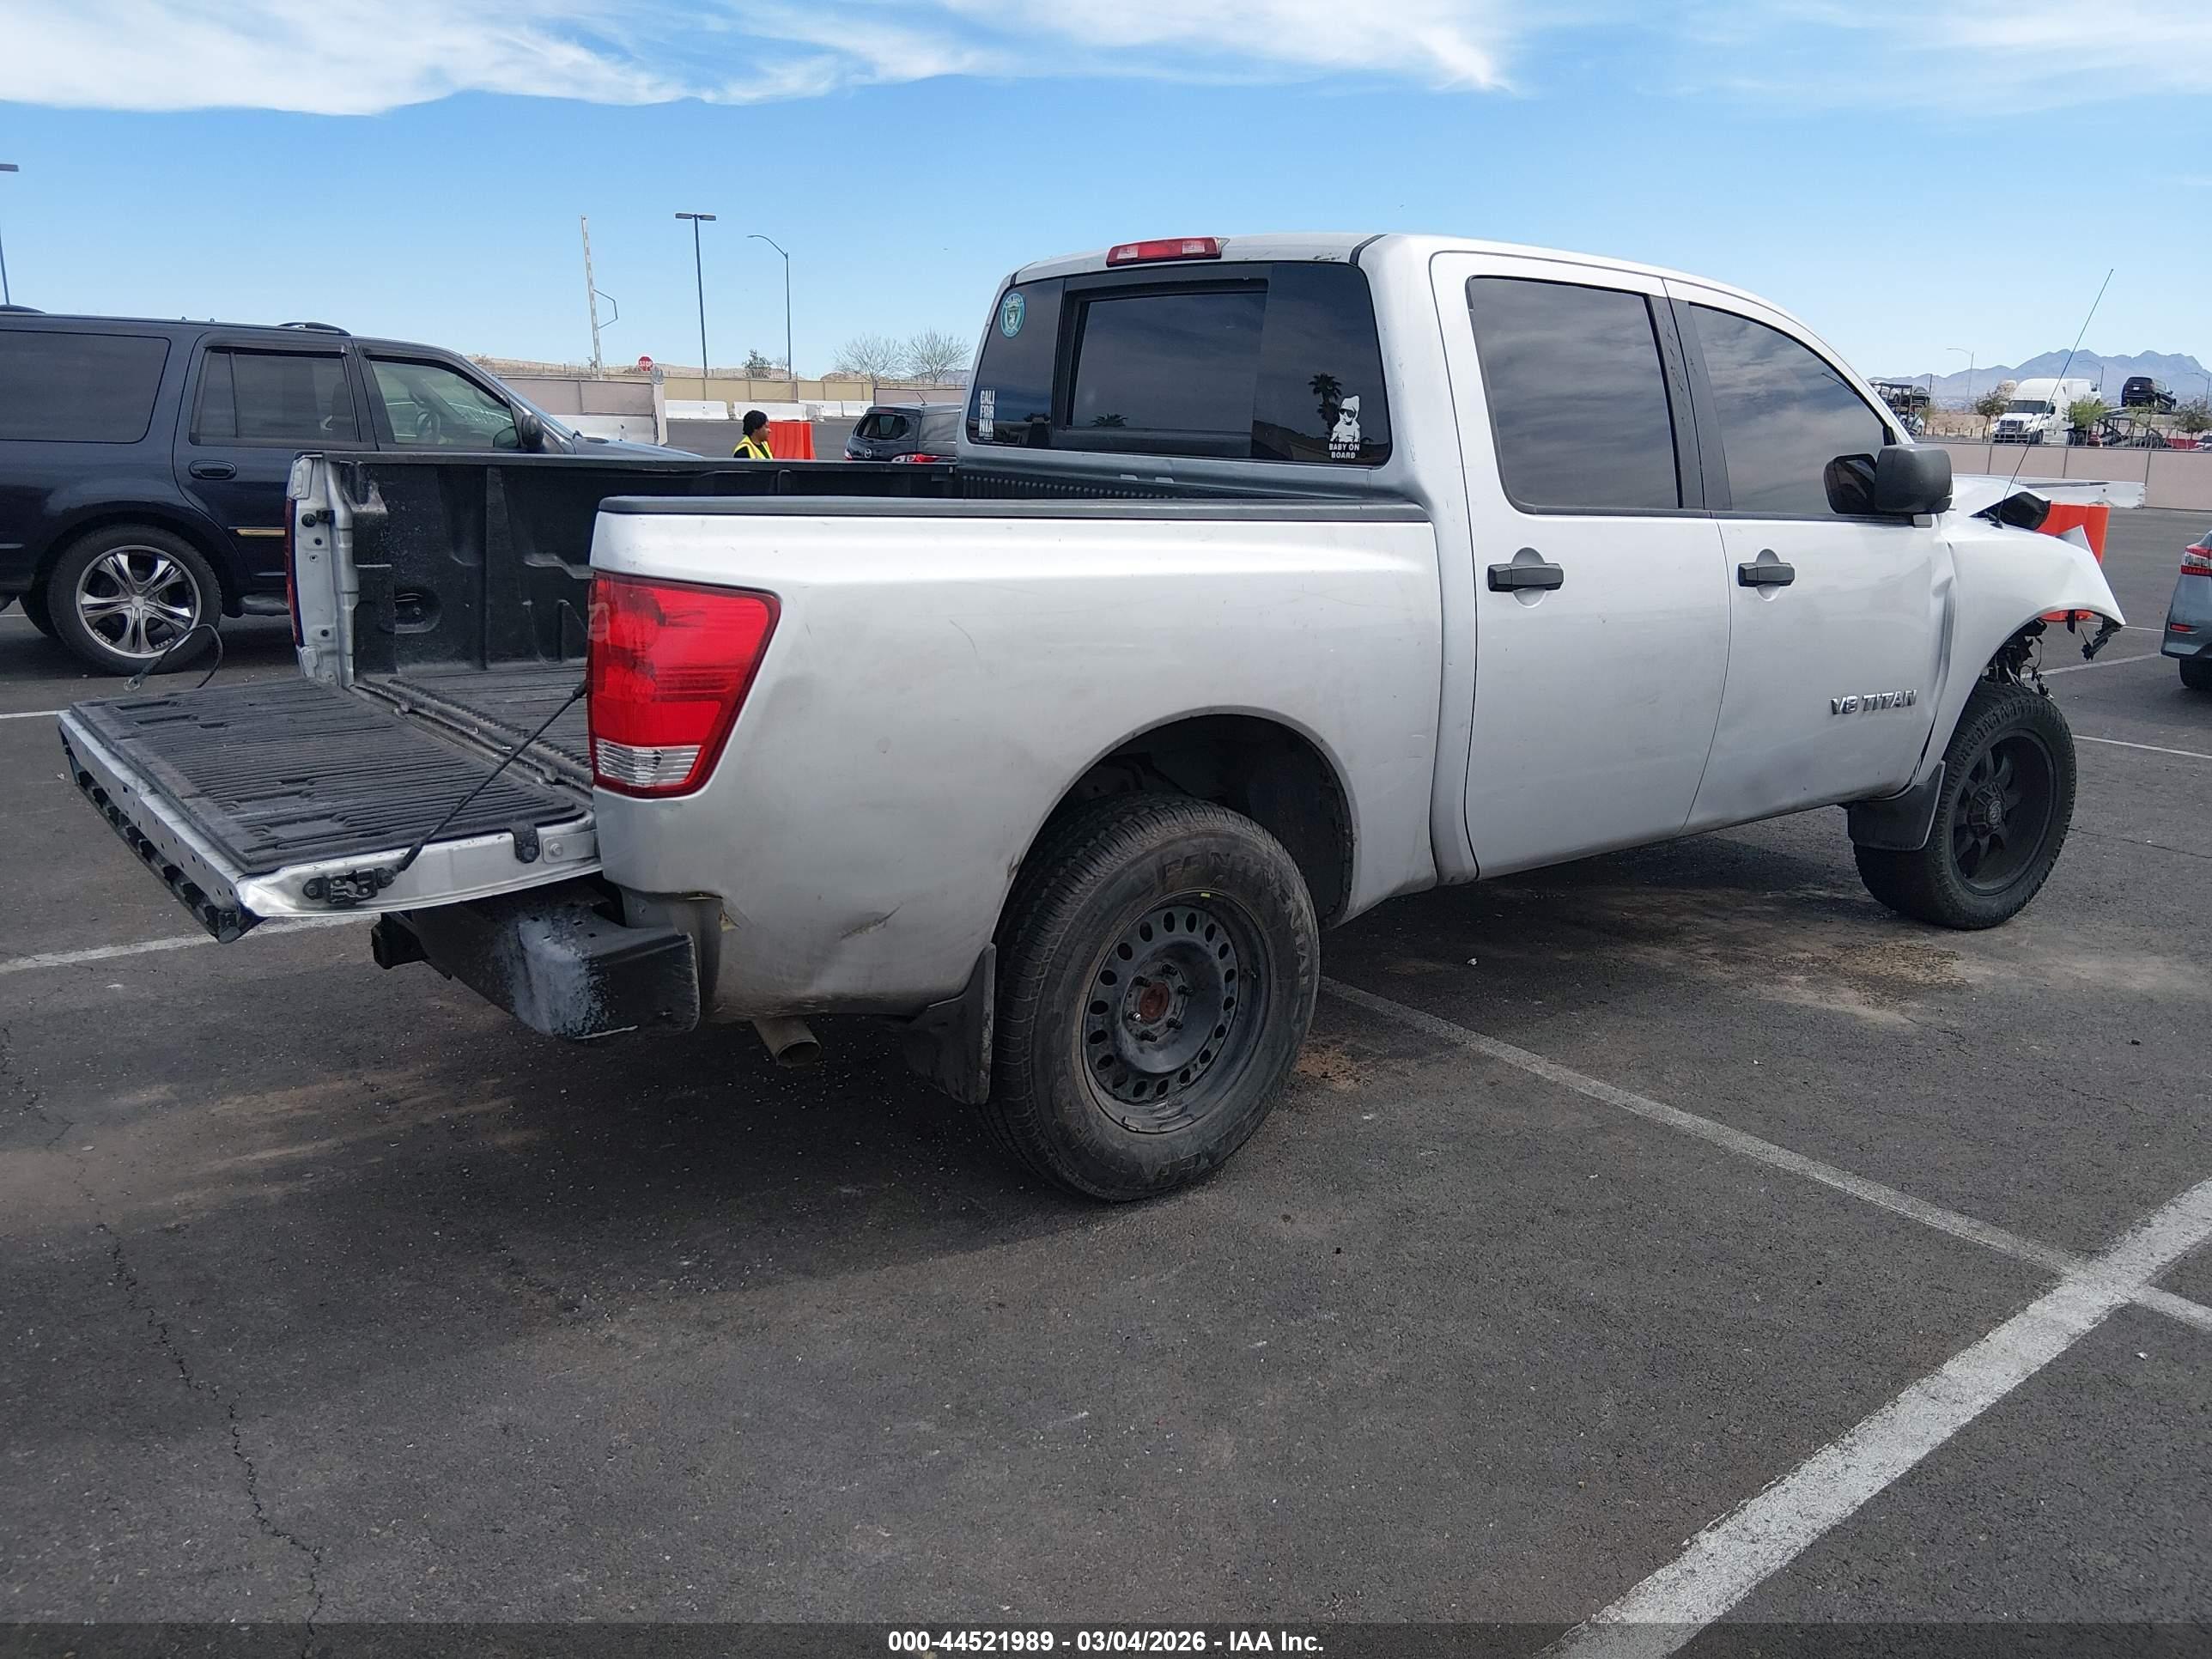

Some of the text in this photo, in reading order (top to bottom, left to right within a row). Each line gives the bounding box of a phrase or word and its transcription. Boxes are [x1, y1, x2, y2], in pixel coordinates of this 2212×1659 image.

[980, 390, 995, 405] CALI
[979, 405, 994, 419] FOR
[979, 419, 994, 433] NIA
[1828, 689, 1917, 714] V8 TITAN
